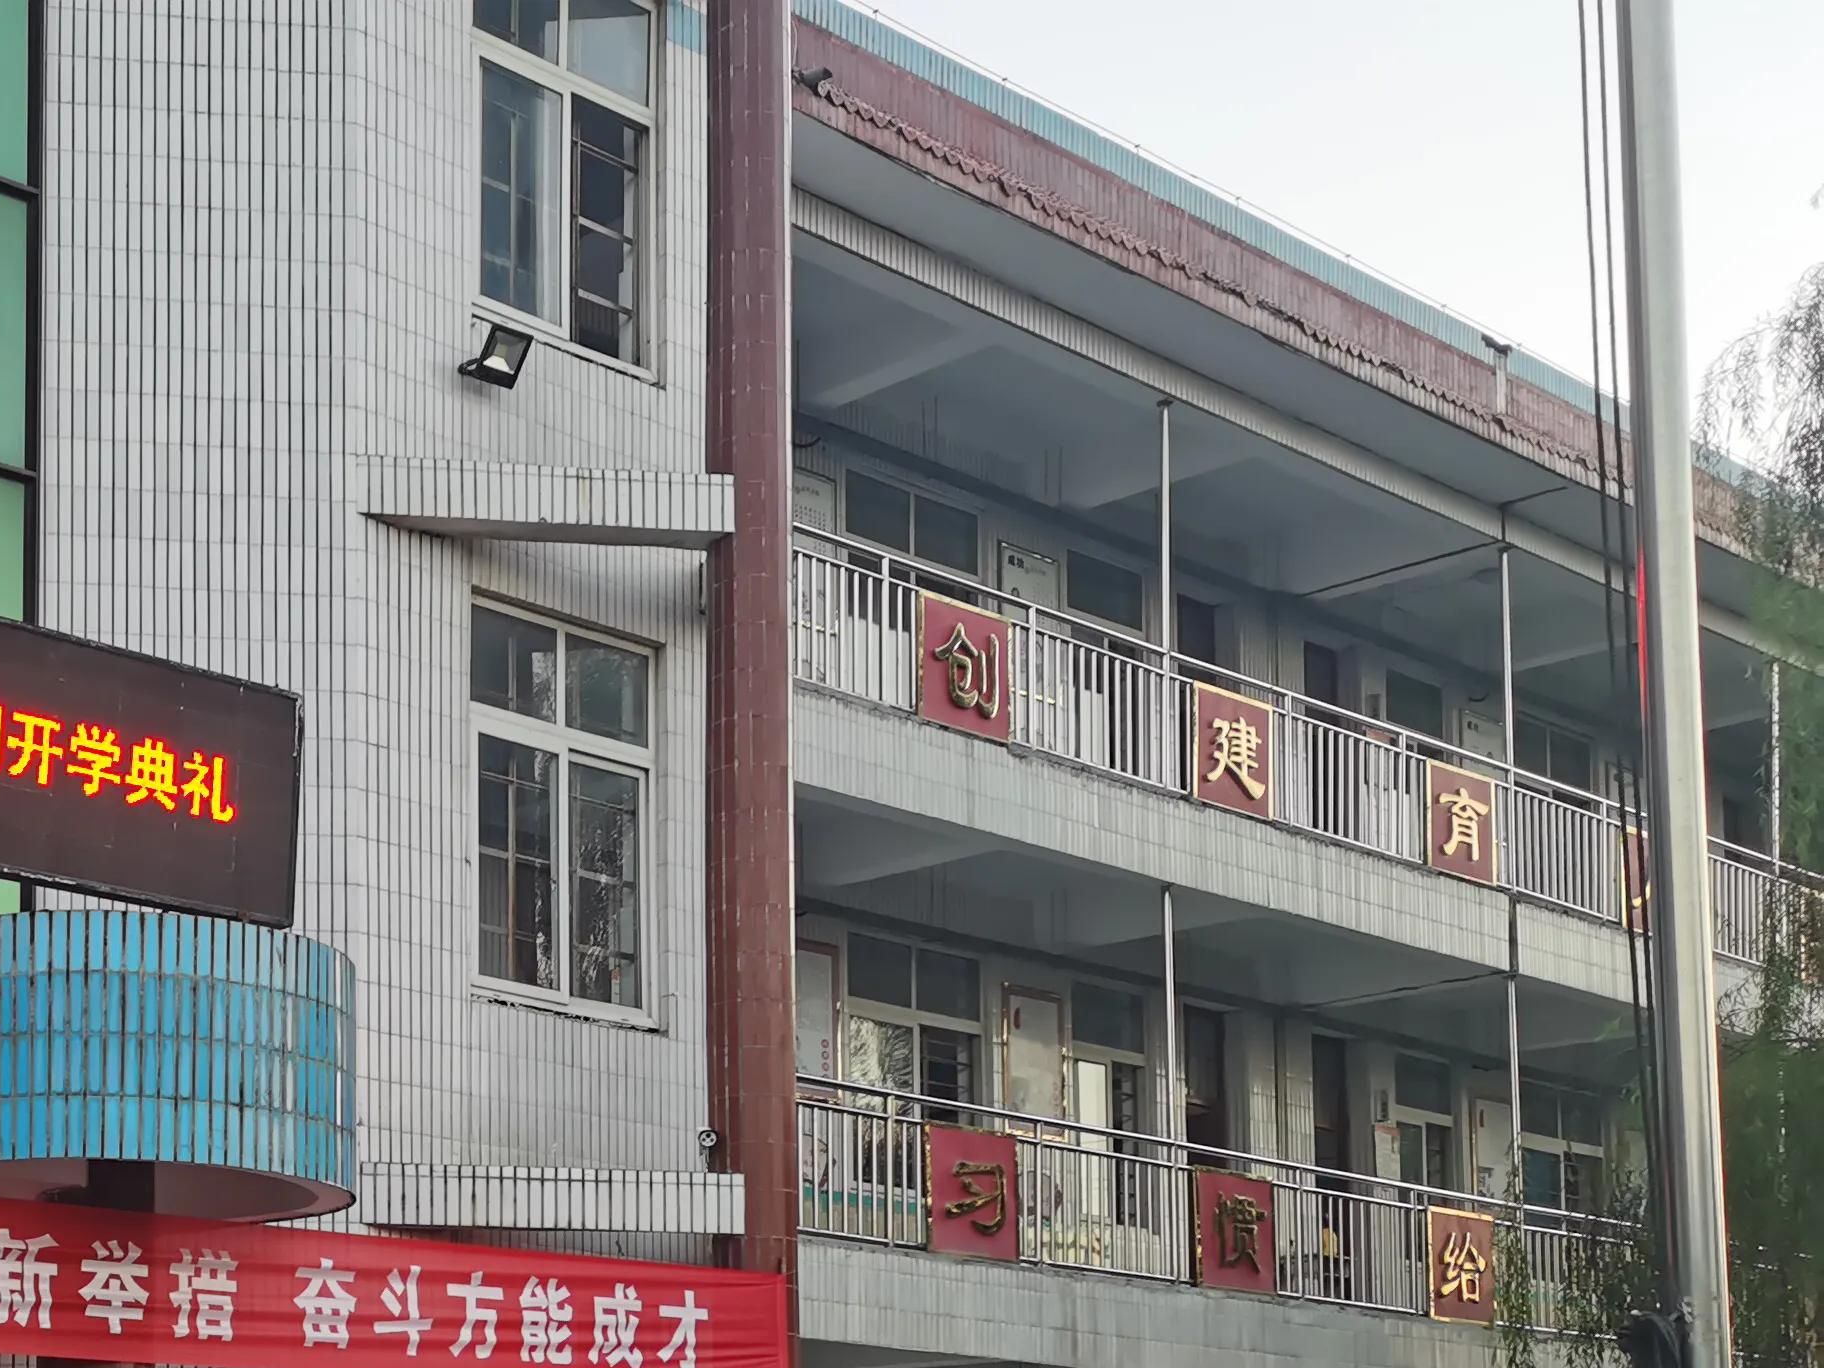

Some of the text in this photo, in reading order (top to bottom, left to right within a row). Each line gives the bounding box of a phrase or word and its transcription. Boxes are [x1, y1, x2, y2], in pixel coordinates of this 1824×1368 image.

[934, 622, 1490, 863] 创 建 育
[946, 1160, 1487, 1304] 习 惯 给
